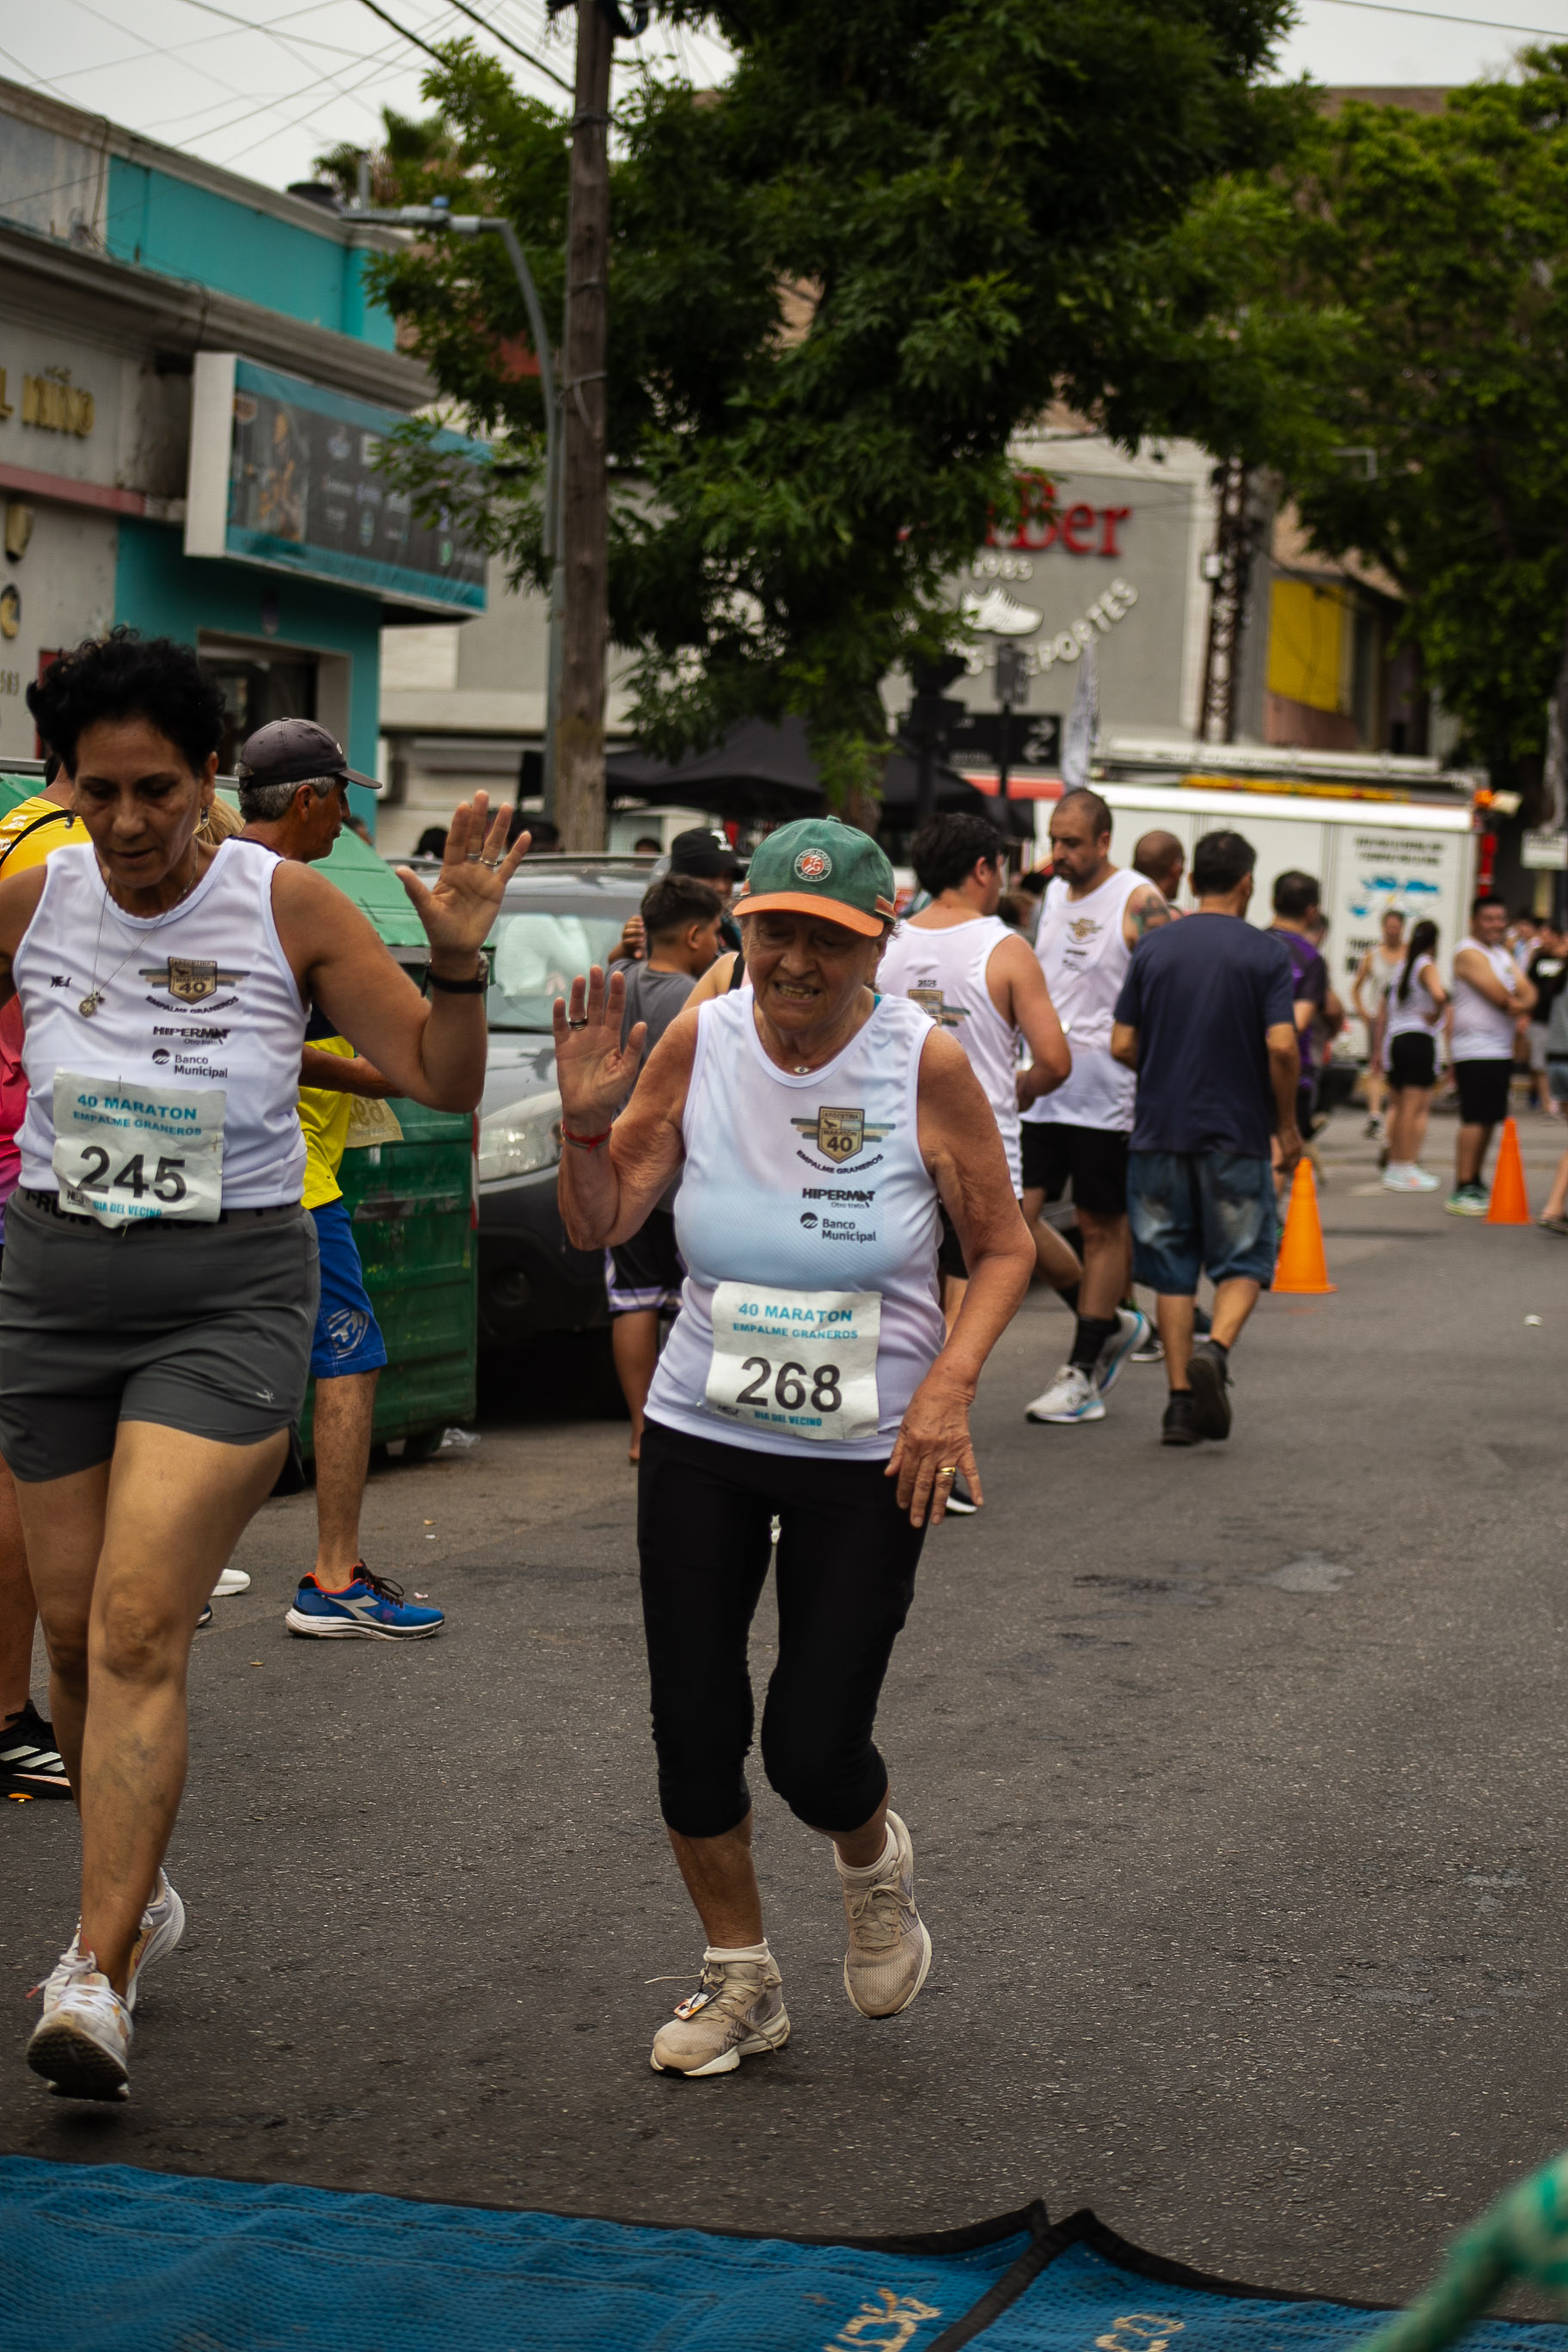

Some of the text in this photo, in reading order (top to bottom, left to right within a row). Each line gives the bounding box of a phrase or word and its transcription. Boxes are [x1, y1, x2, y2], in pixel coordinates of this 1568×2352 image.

[179, 982, 206, 994] 40
[145, 995, 240, 1014] EMPALME GRANEROS
[175, 1054, 209, 1065] Banco
[174, 1065, 228, 1079] Municipal
[77, 1094, 198, 1121] 40 MARATON
[73, 1110, 202, 1136] EMPALME GRANEROS
[827, 1136, 853, 1152] 40
[796, 1149, 884, 1174] EMPALME GRANEROS
[77, 1146, 187, 1204] 245
[110, 1203, 125, 1214] DEL
[823, 1218, 856, 1229] Banco
[822, 1230, 877, 1244] Municipal
[738, 1303, 854, 1324] 40 MARATON
[732, 1322, 859, 1340] EMPALME GRANEROS
[736, 1357, 842, 1412] 268
[772, 1413, 787, 1424] DEL
[788, 1415, 823, 1427] VECINO
